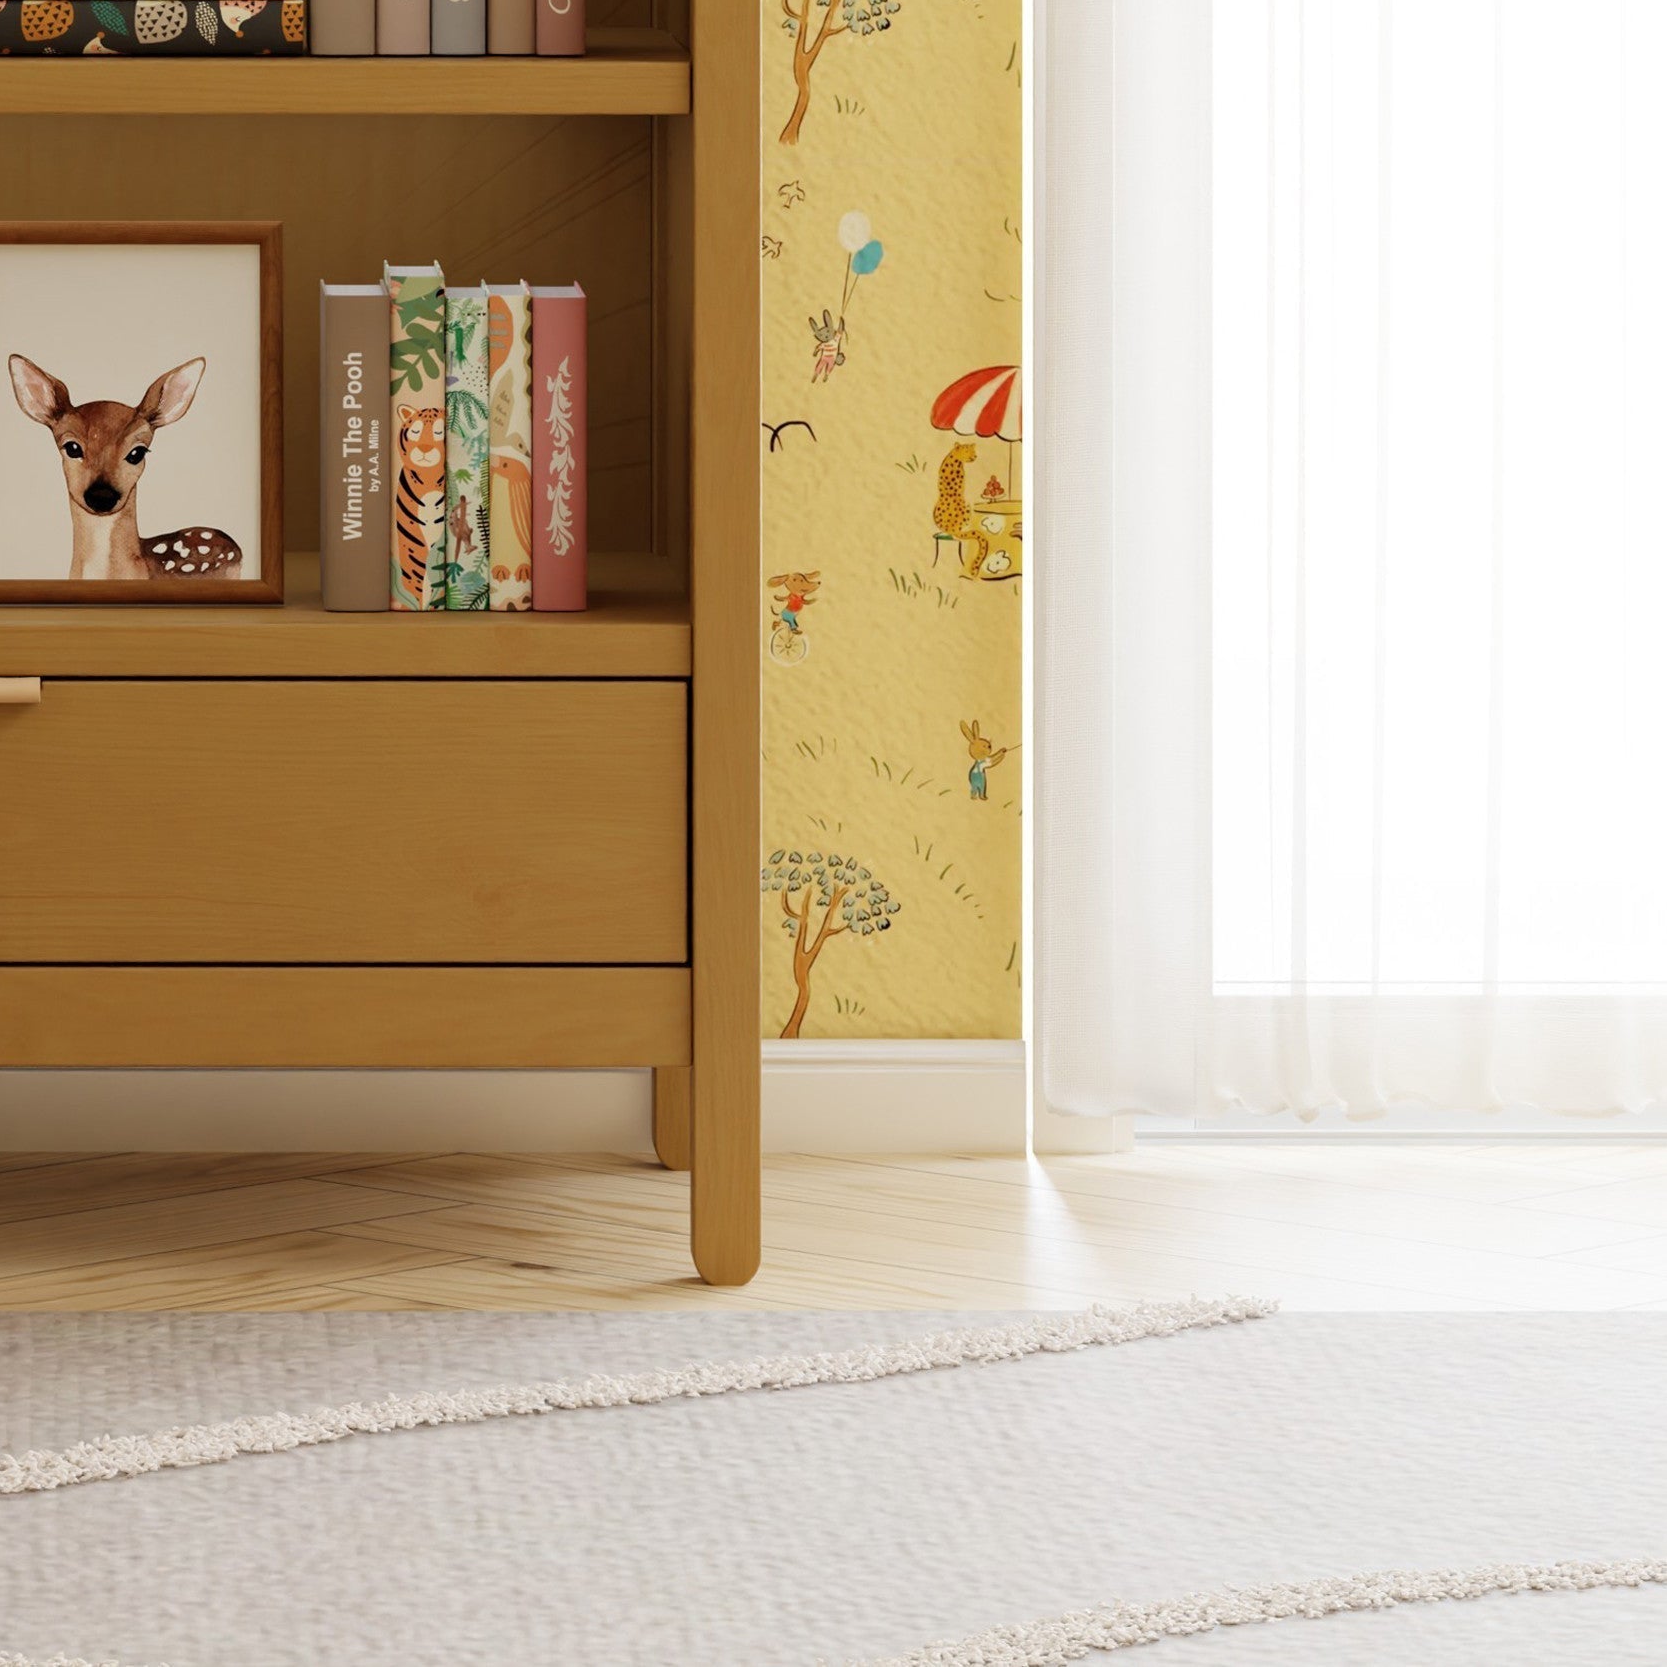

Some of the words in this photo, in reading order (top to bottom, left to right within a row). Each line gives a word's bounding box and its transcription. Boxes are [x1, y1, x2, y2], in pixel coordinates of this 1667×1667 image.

[343, 352, 363, 409] Pooh
[343, 416, 363, 458] The
[369, 419, 380, 449] Milne
[369, 453, 379, 476] A.A.
[343, 464, 363, 540] Winnie
[369, 479, 381, 493] by
